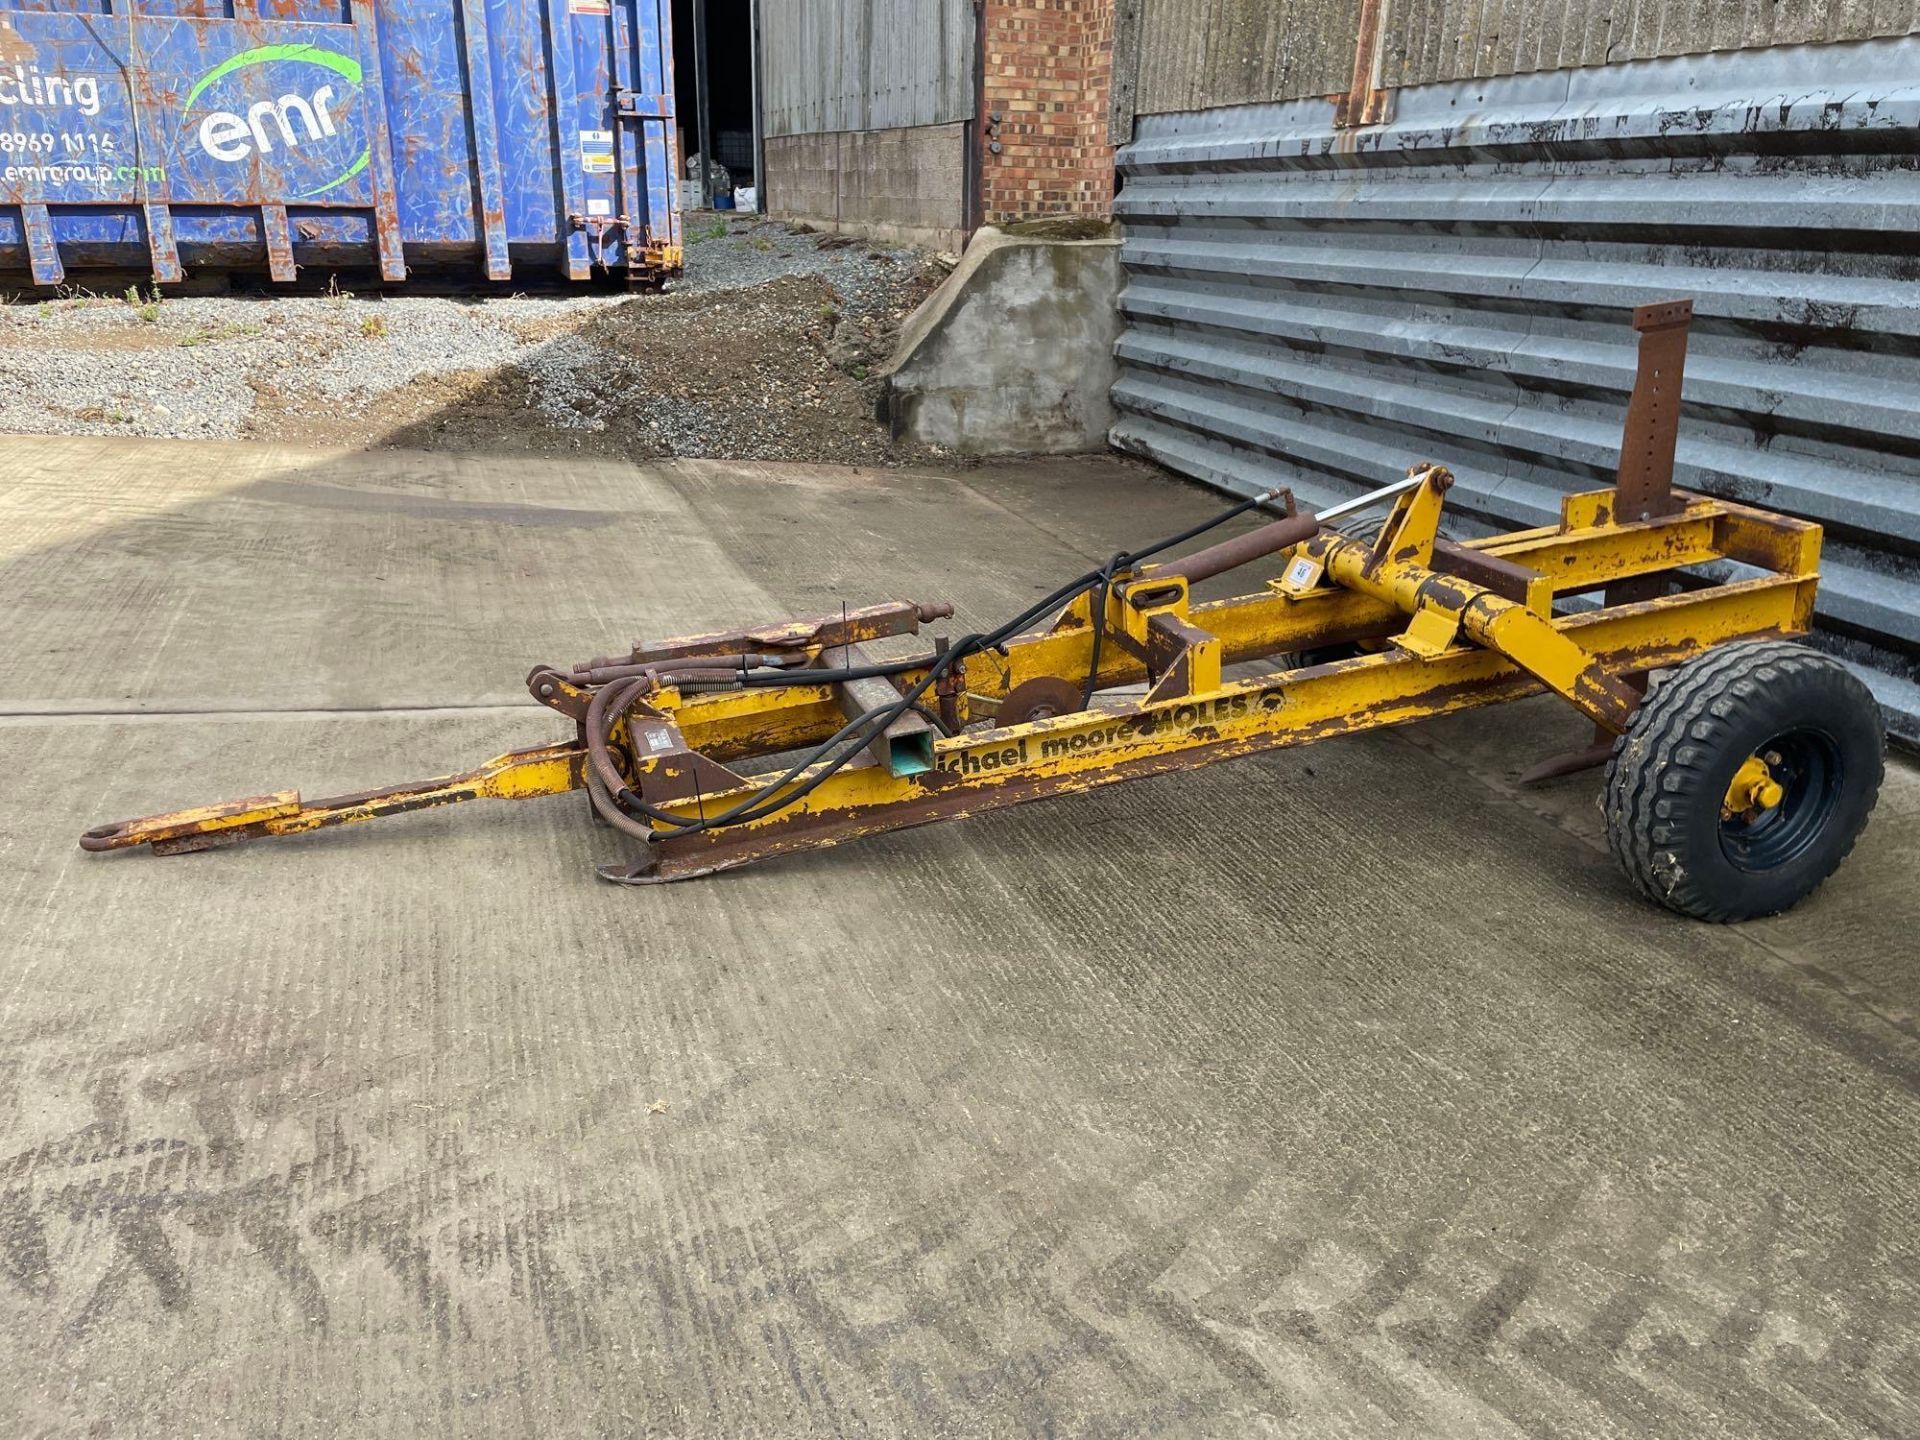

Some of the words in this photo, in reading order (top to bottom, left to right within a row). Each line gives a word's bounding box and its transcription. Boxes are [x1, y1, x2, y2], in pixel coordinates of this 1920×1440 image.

[200, 85, 337, 162] emr
[935, 738, 1028, 775] ichael
[1040, 722, 1134, 759] moore
